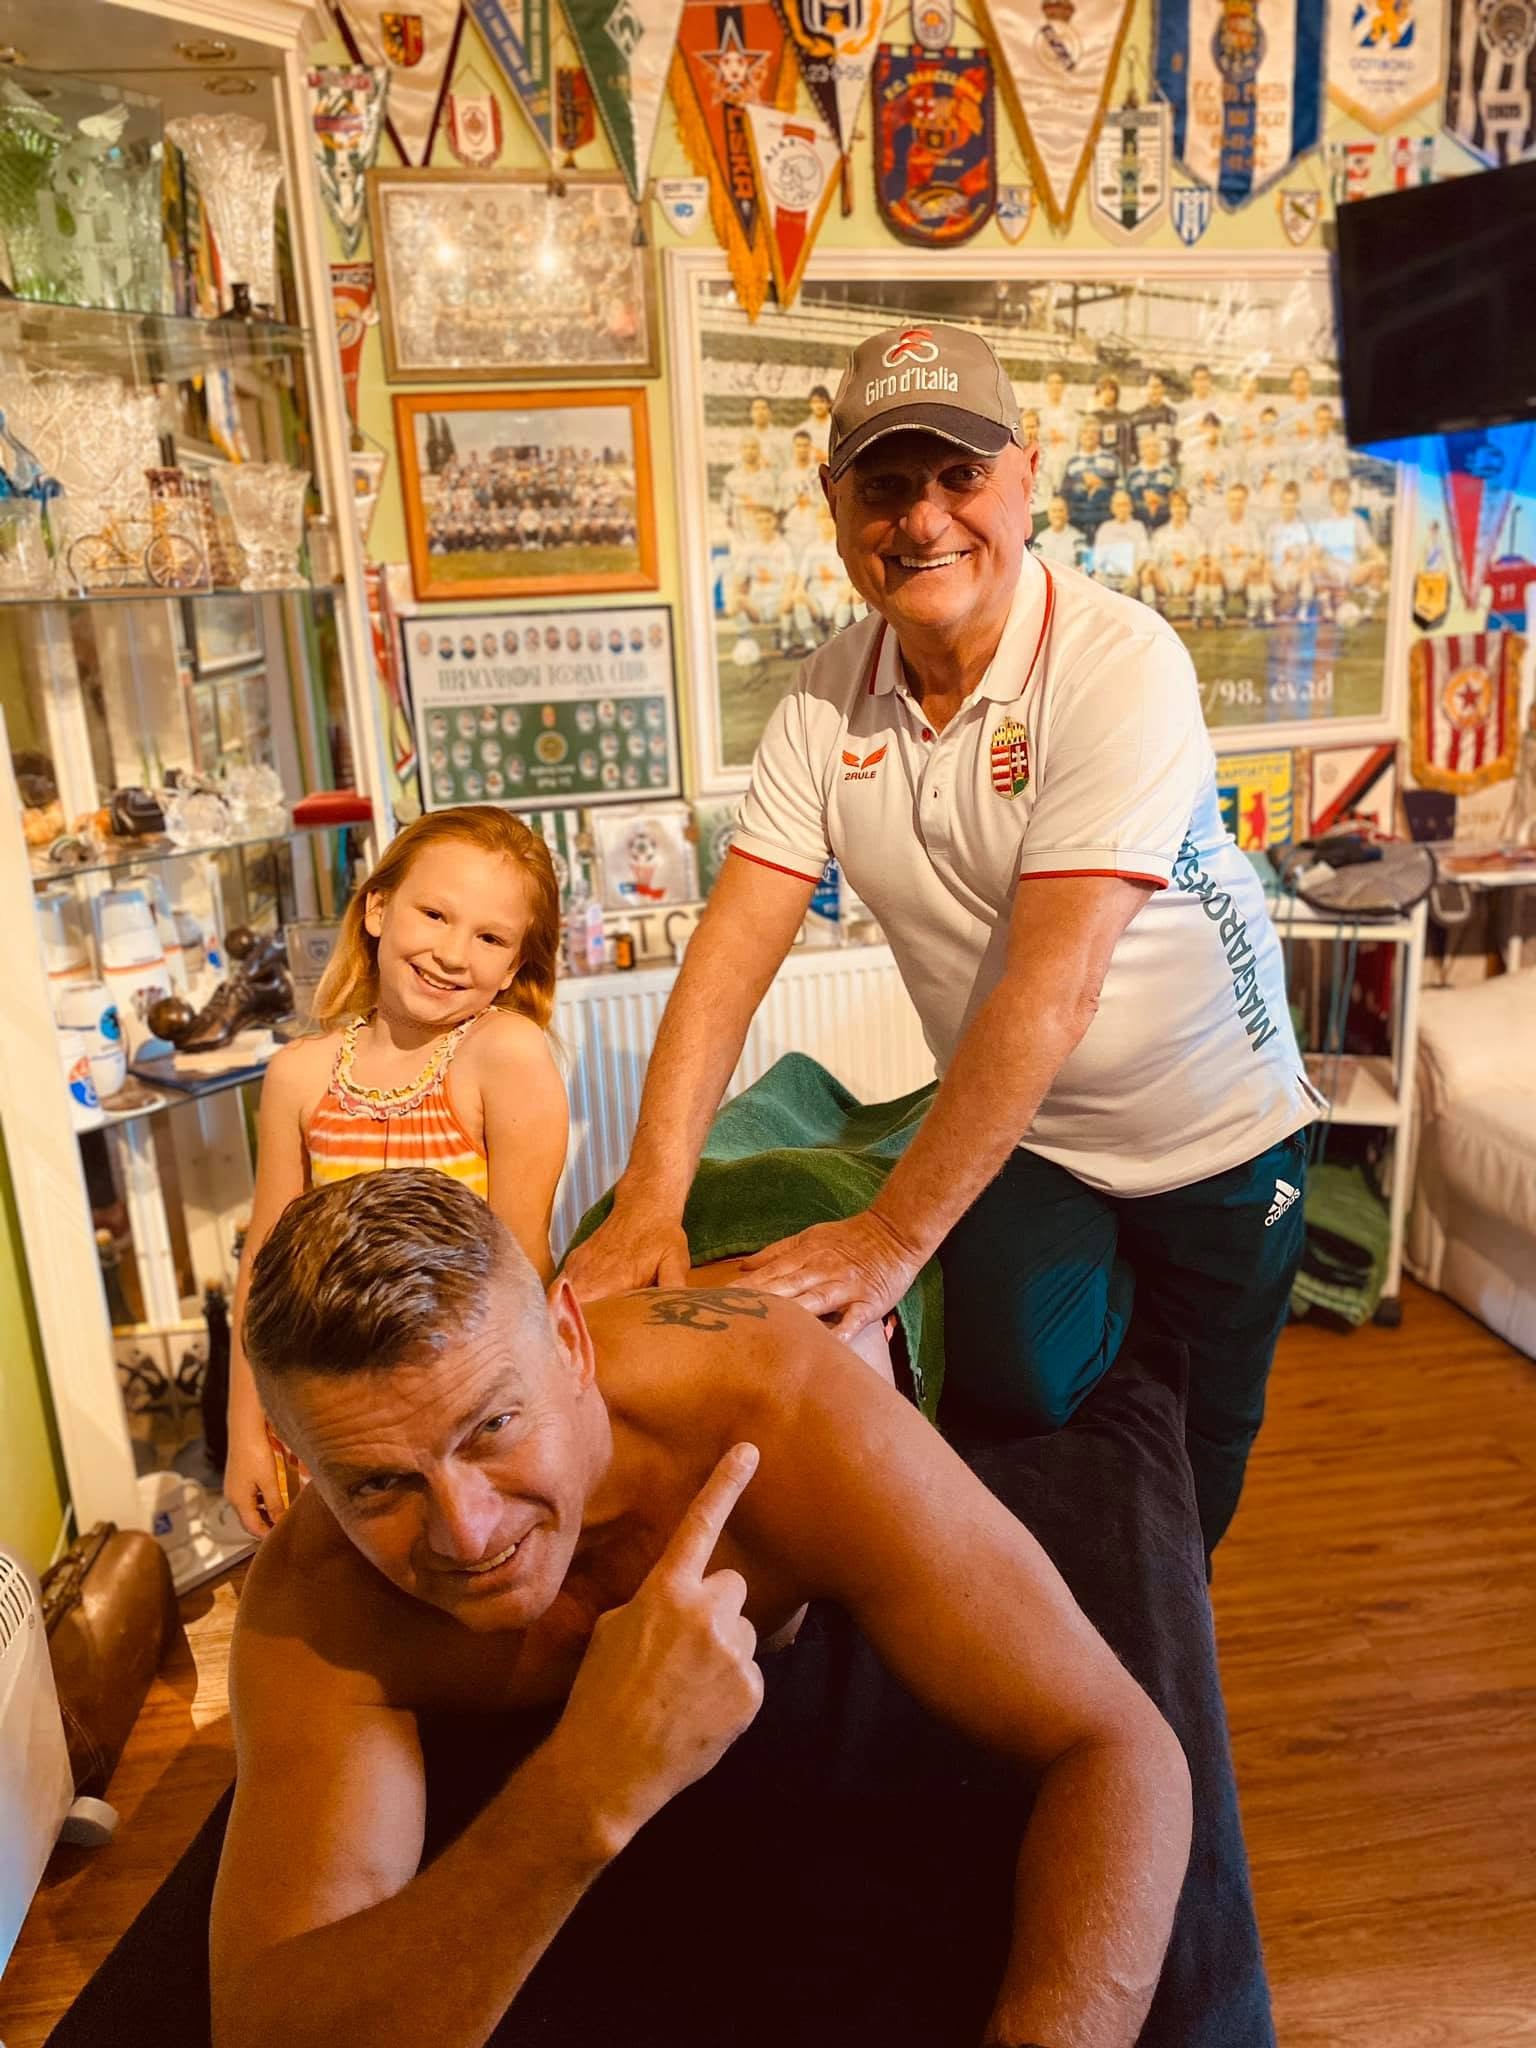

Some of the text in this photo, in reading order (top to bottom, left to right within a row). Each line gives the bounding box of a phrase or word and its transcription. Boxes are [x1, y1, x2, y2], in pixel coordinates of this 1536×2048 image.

[764, 137, 797, 164] AJAX
[865, 366, 959, 406] Giro d'Italia
[844, 770, 877, 781] 2RULE
[1263, 1187, 1301, 1227] adidas
